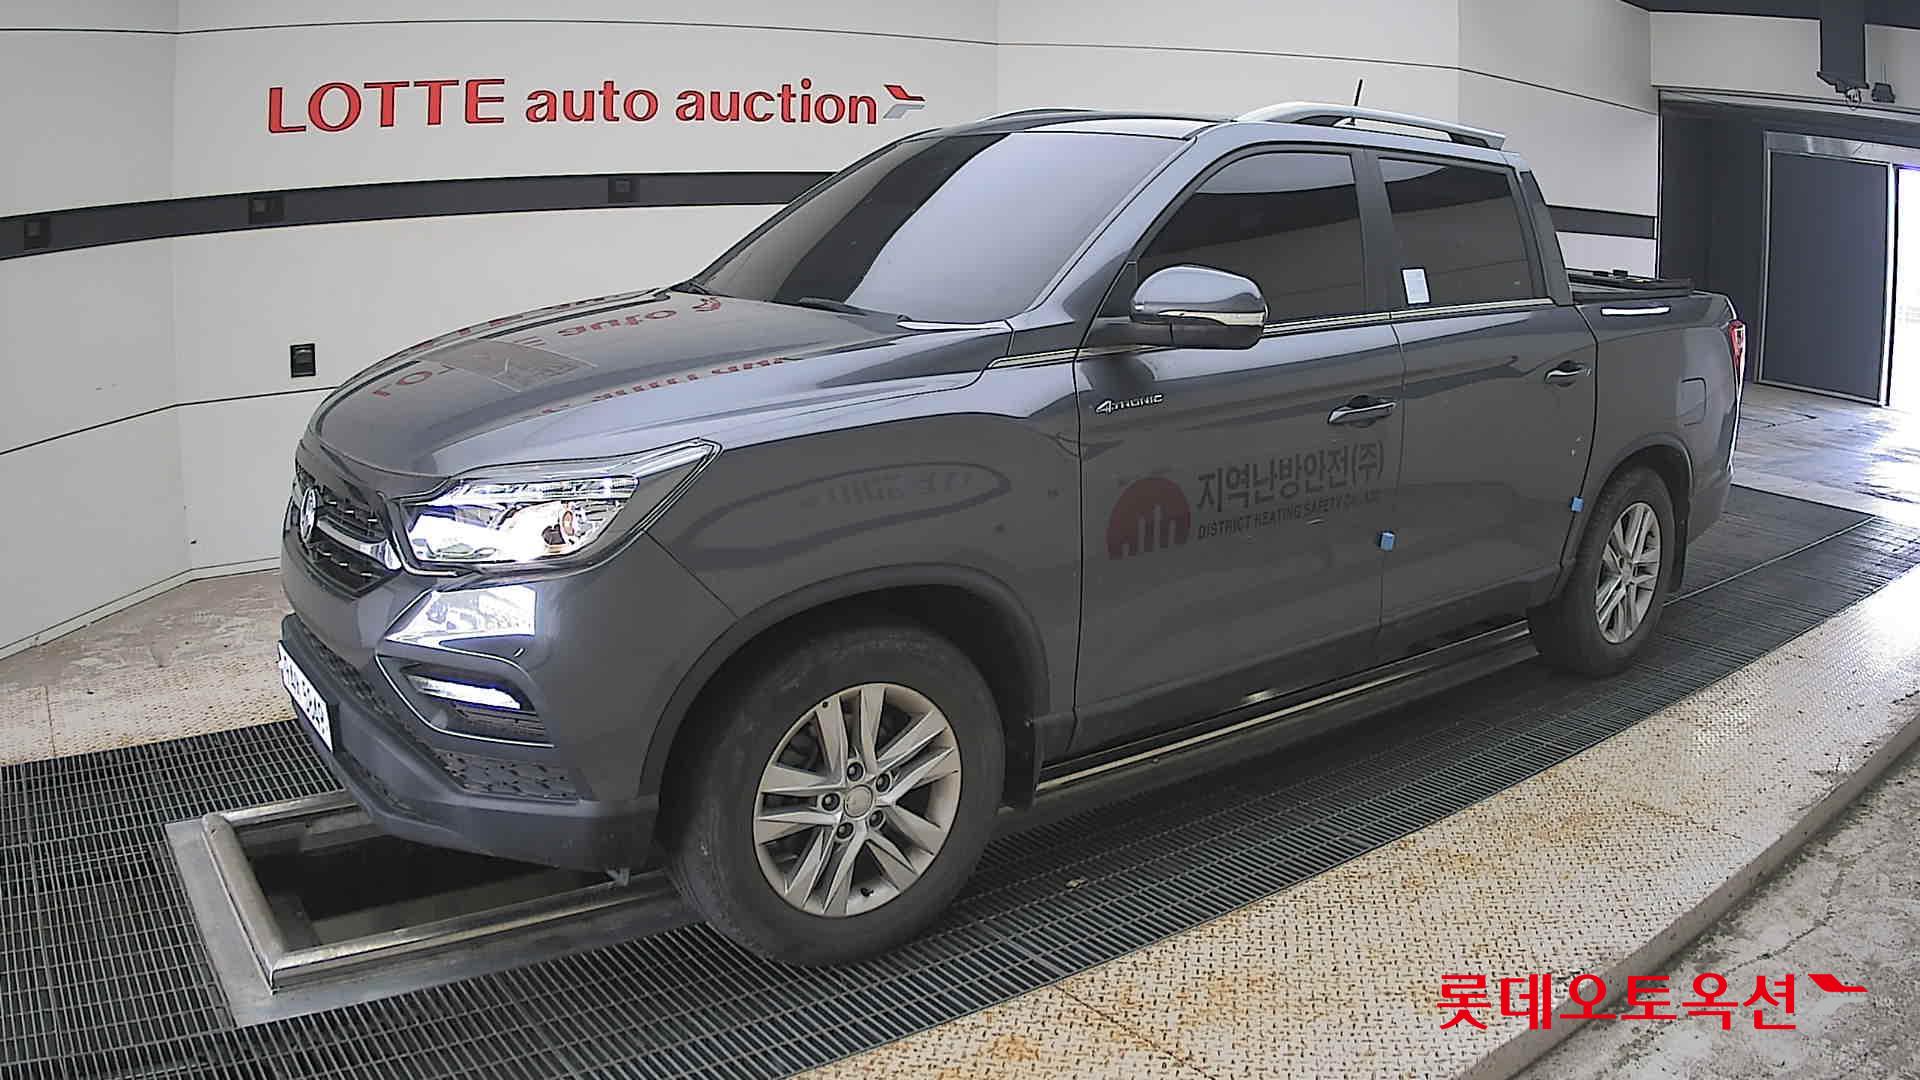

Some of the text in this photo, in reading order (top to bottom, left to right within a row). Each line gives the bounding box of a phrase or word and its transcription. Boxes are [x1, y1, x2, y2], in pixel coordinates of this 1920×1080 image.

[267, 78, 878, 134] LOTTE auto auction
[1196, 439, 1385, 513] 지역난방안전(주)
[1198, 515, 1251, 540] DISTRICT
[1253, 503, 1302, 529] HEATING
